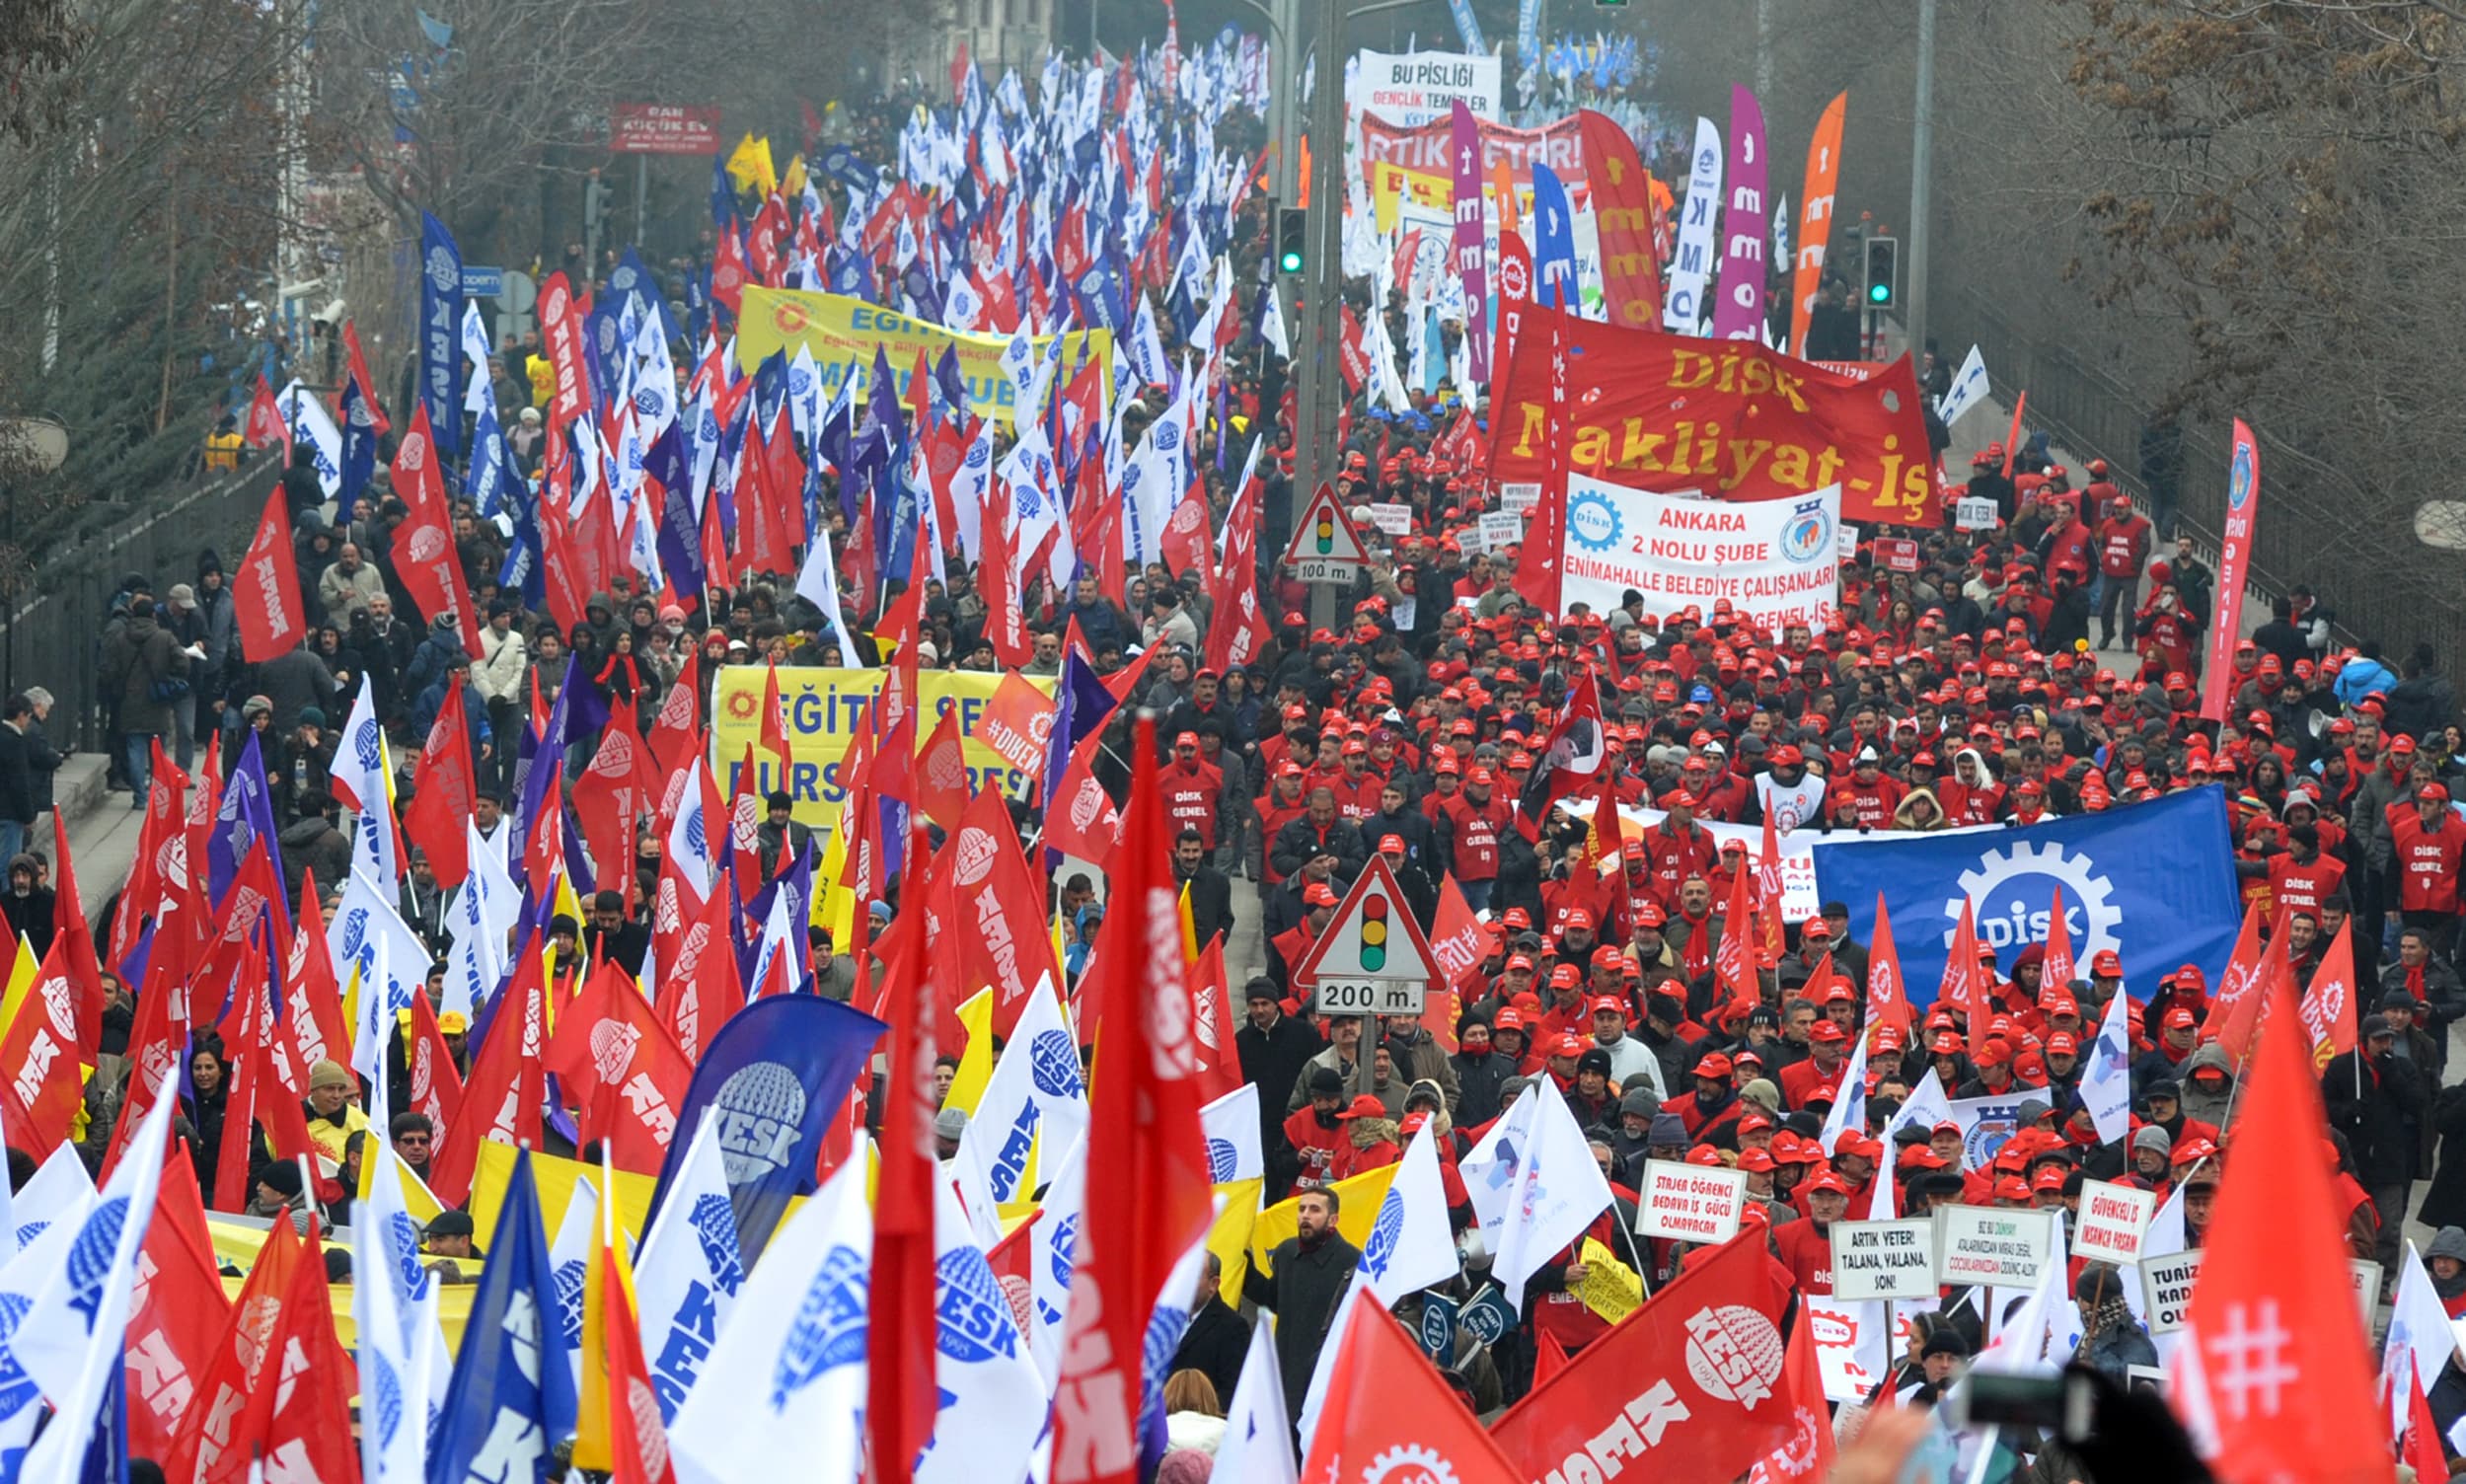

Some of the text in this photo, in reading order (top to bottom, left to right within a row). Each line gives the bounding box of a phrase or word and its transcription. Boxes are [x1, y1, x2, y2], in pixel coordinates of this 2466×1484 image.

[1392, 61, 1473, 87] BU PİSLİĞİ
[1374, 91, 1486, 111] GENÇLİK TEMLER
[1368, 133, 1451, 167] RTIK
[1667, 346, 1810, 412] DİSK
[1576, 511, 1610, 530] DİSK
[1659, 508, 1746, 532] ANKARA
[1632, 535, 1768, 566] 2 NOLU ŞUBE
[1302, 563, 1352, 582] 100 m.
[1564, 553, 1835, 602] ENİMAHALLE BELEDİYE ÇALIŞANLARI
[1175, 790, 1202, 803] DİSK
[1172, 806, 1208, 817] GENEL
[1343, 803, 1361, 816] DİS
[2415, 846, 2442, 857] DİSK
[2284, 878, 2315, 890] DİSK
[1982, 900, 2083, 948] DİSK
[1324, 986, 1418, 1007] 200 m.
[1030, 1037, 1084, 1100] KESK
[1690, 1175, 1734, 1199] ÖĞRENCİ
[1652, 1196, 1732, 1217] BEDAVA İŞ GÜCÜ
[2091, 1191, 2131, 1222] GÜVENCELİ
[1661, 1216, 1717, 1234] OLMAYACAK
[1851, 1229, 1915, 1247] ARTIK YETER!
[1842, 1252, 1928, 1270] TALANA, YALANA,
[1814, 1270, 1833, 1285] DİS
[1875, 1274, 1897, 1291] SON!
[2152, 1262, 2201, 1284] TURİZ
[2157, 1287, 2195, 1304] KAD
[2161, 1307, 2189, 1324] OL
[1683, 1306, 1773, 1411] KESK
[1691, 1359, 1719, 1389] 1995
